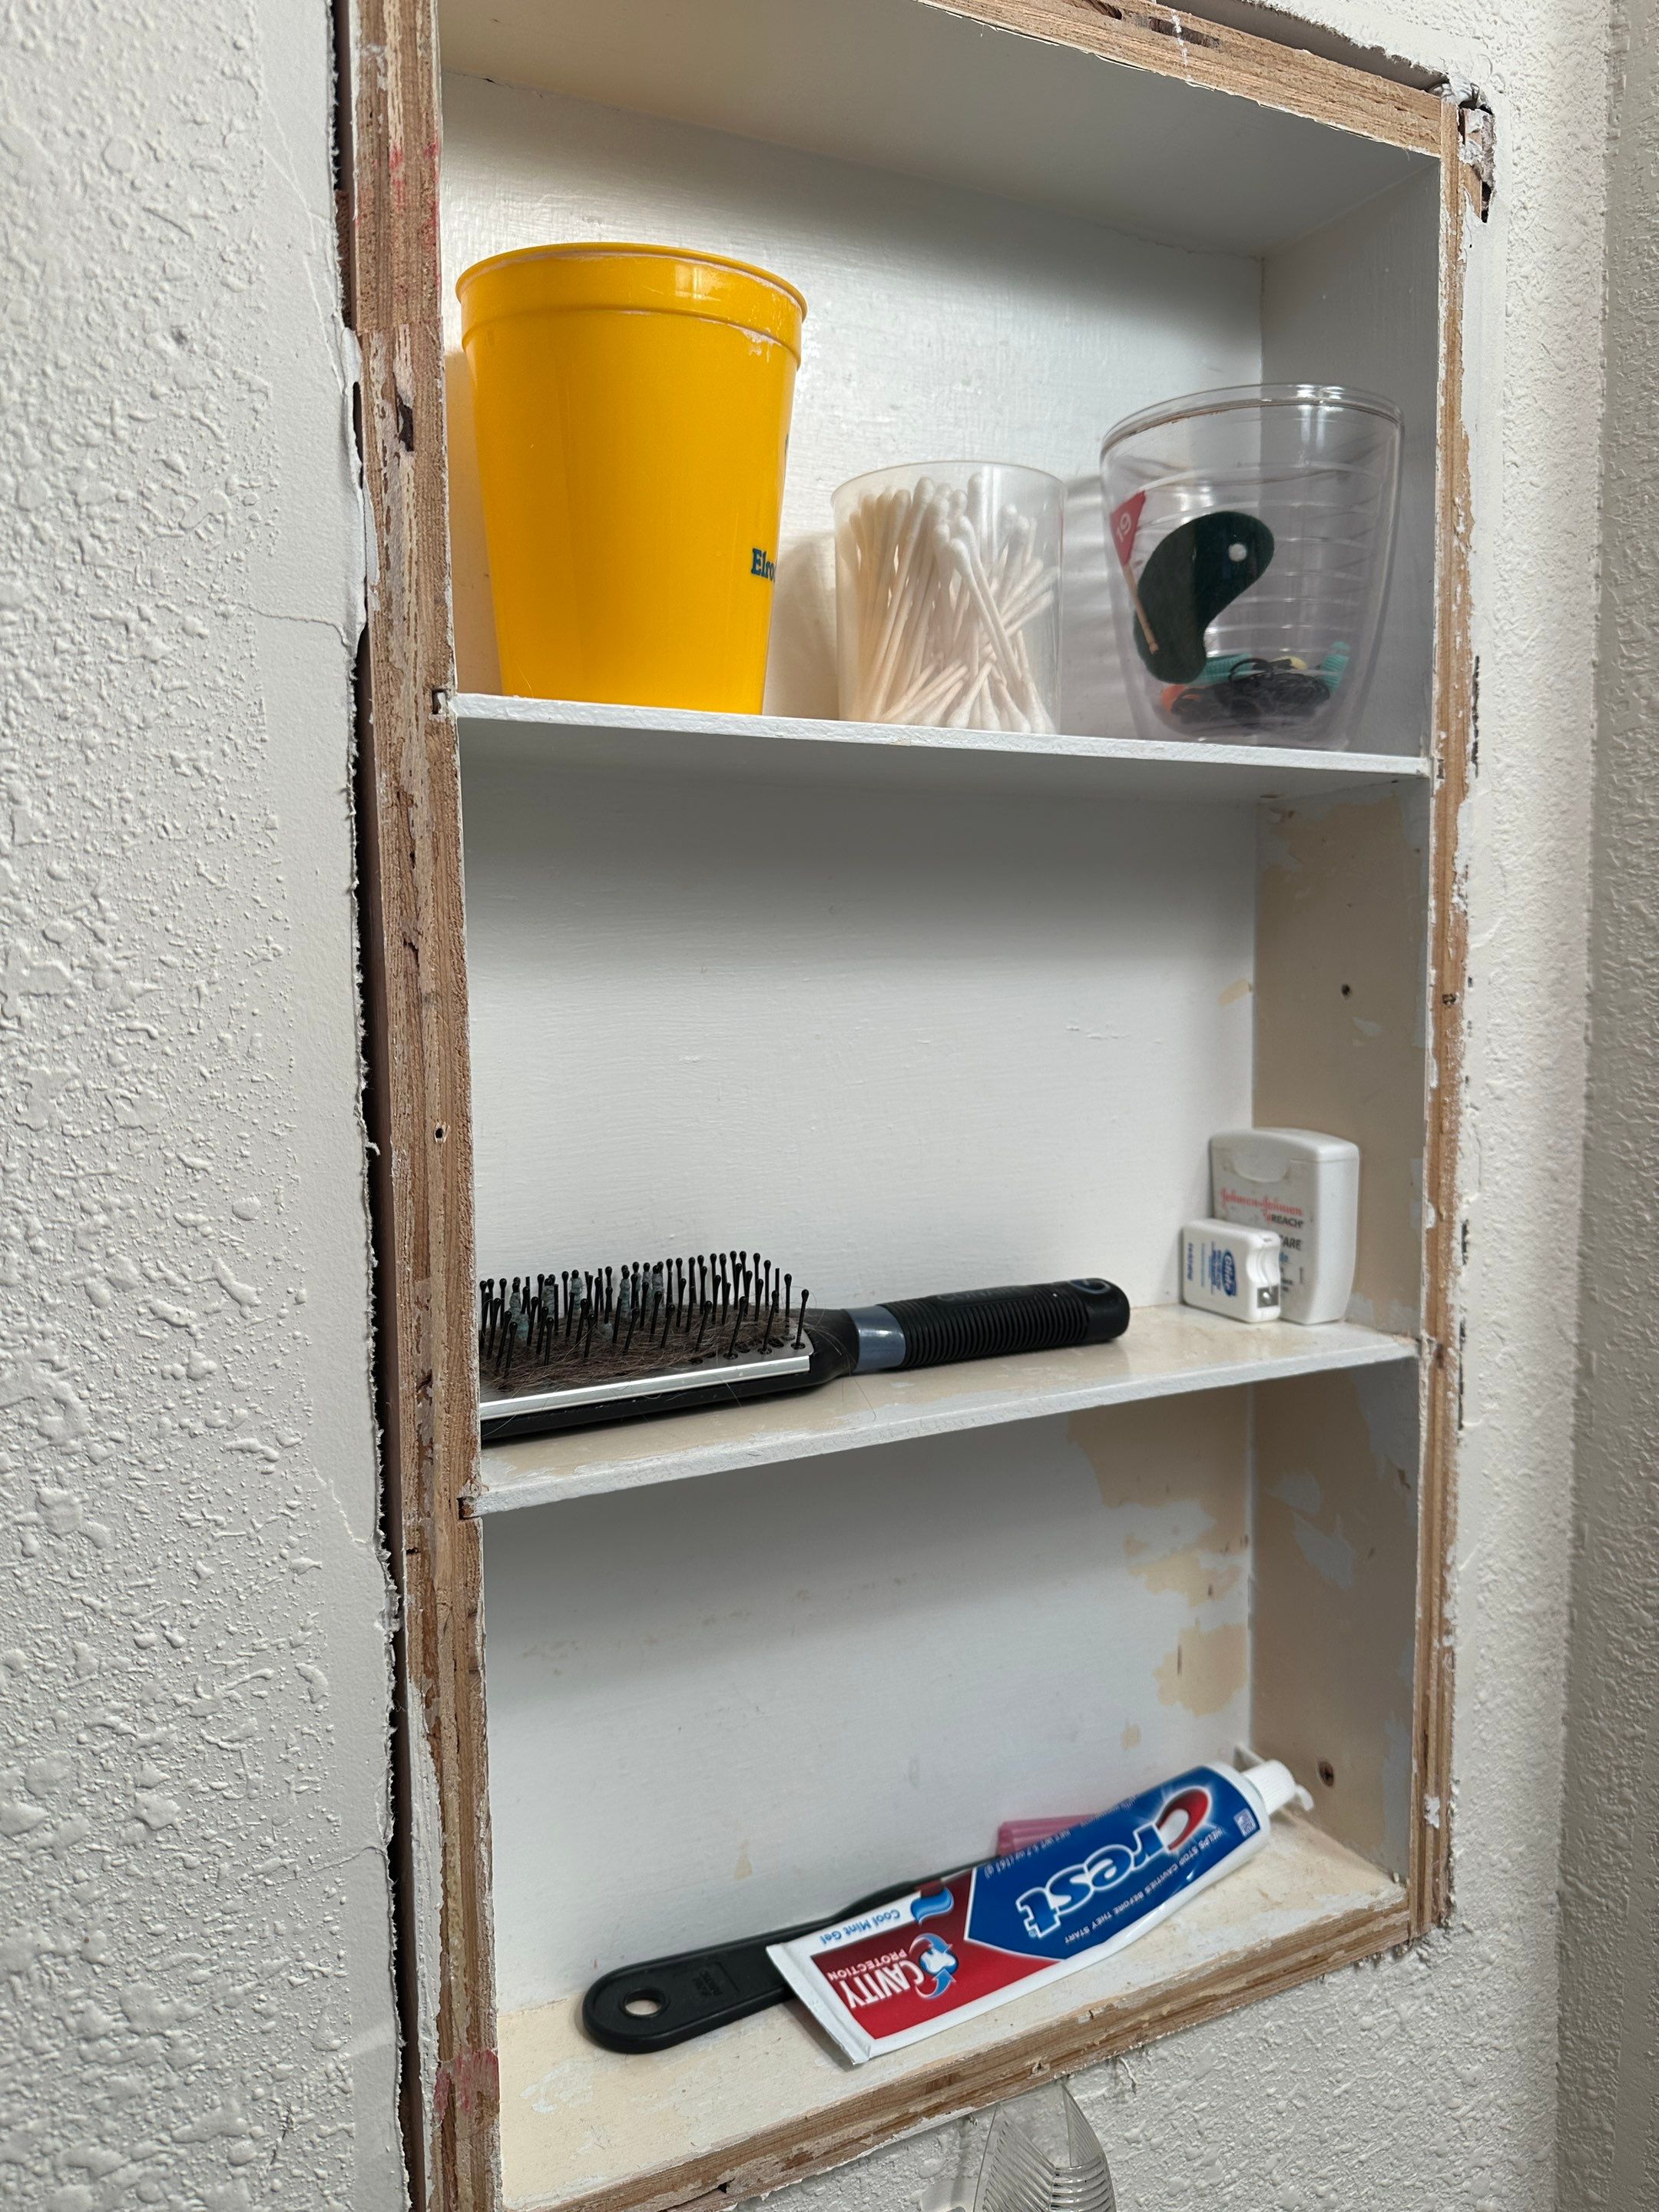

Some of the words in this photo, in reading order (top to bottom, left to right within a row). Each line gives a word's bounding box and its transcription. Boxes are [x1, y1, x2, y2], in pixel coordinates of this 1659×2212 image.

[1199, 1827, 1224, 1849] HELPS
[1015, 1786, 1211, 1938] Crest
[1179, 1847, 1200, 1866] STOP
[1144, 1864, 1179, 1894] CAVITIES
[1112, 1892, 1144, 1915] BEFORE
[843, 1919, 872, 1936] Mint
[872, 1909, 901, 1929] Cool
[1091, 1911, 1113, 1929] THEY
[820, 1930, 842, 1945] Gel
[1065, 1926, 1090, 1944] START
[826, 1949, 908, 1981] PROTECTION
[839, 1959, 925, 2009] CAVITY
